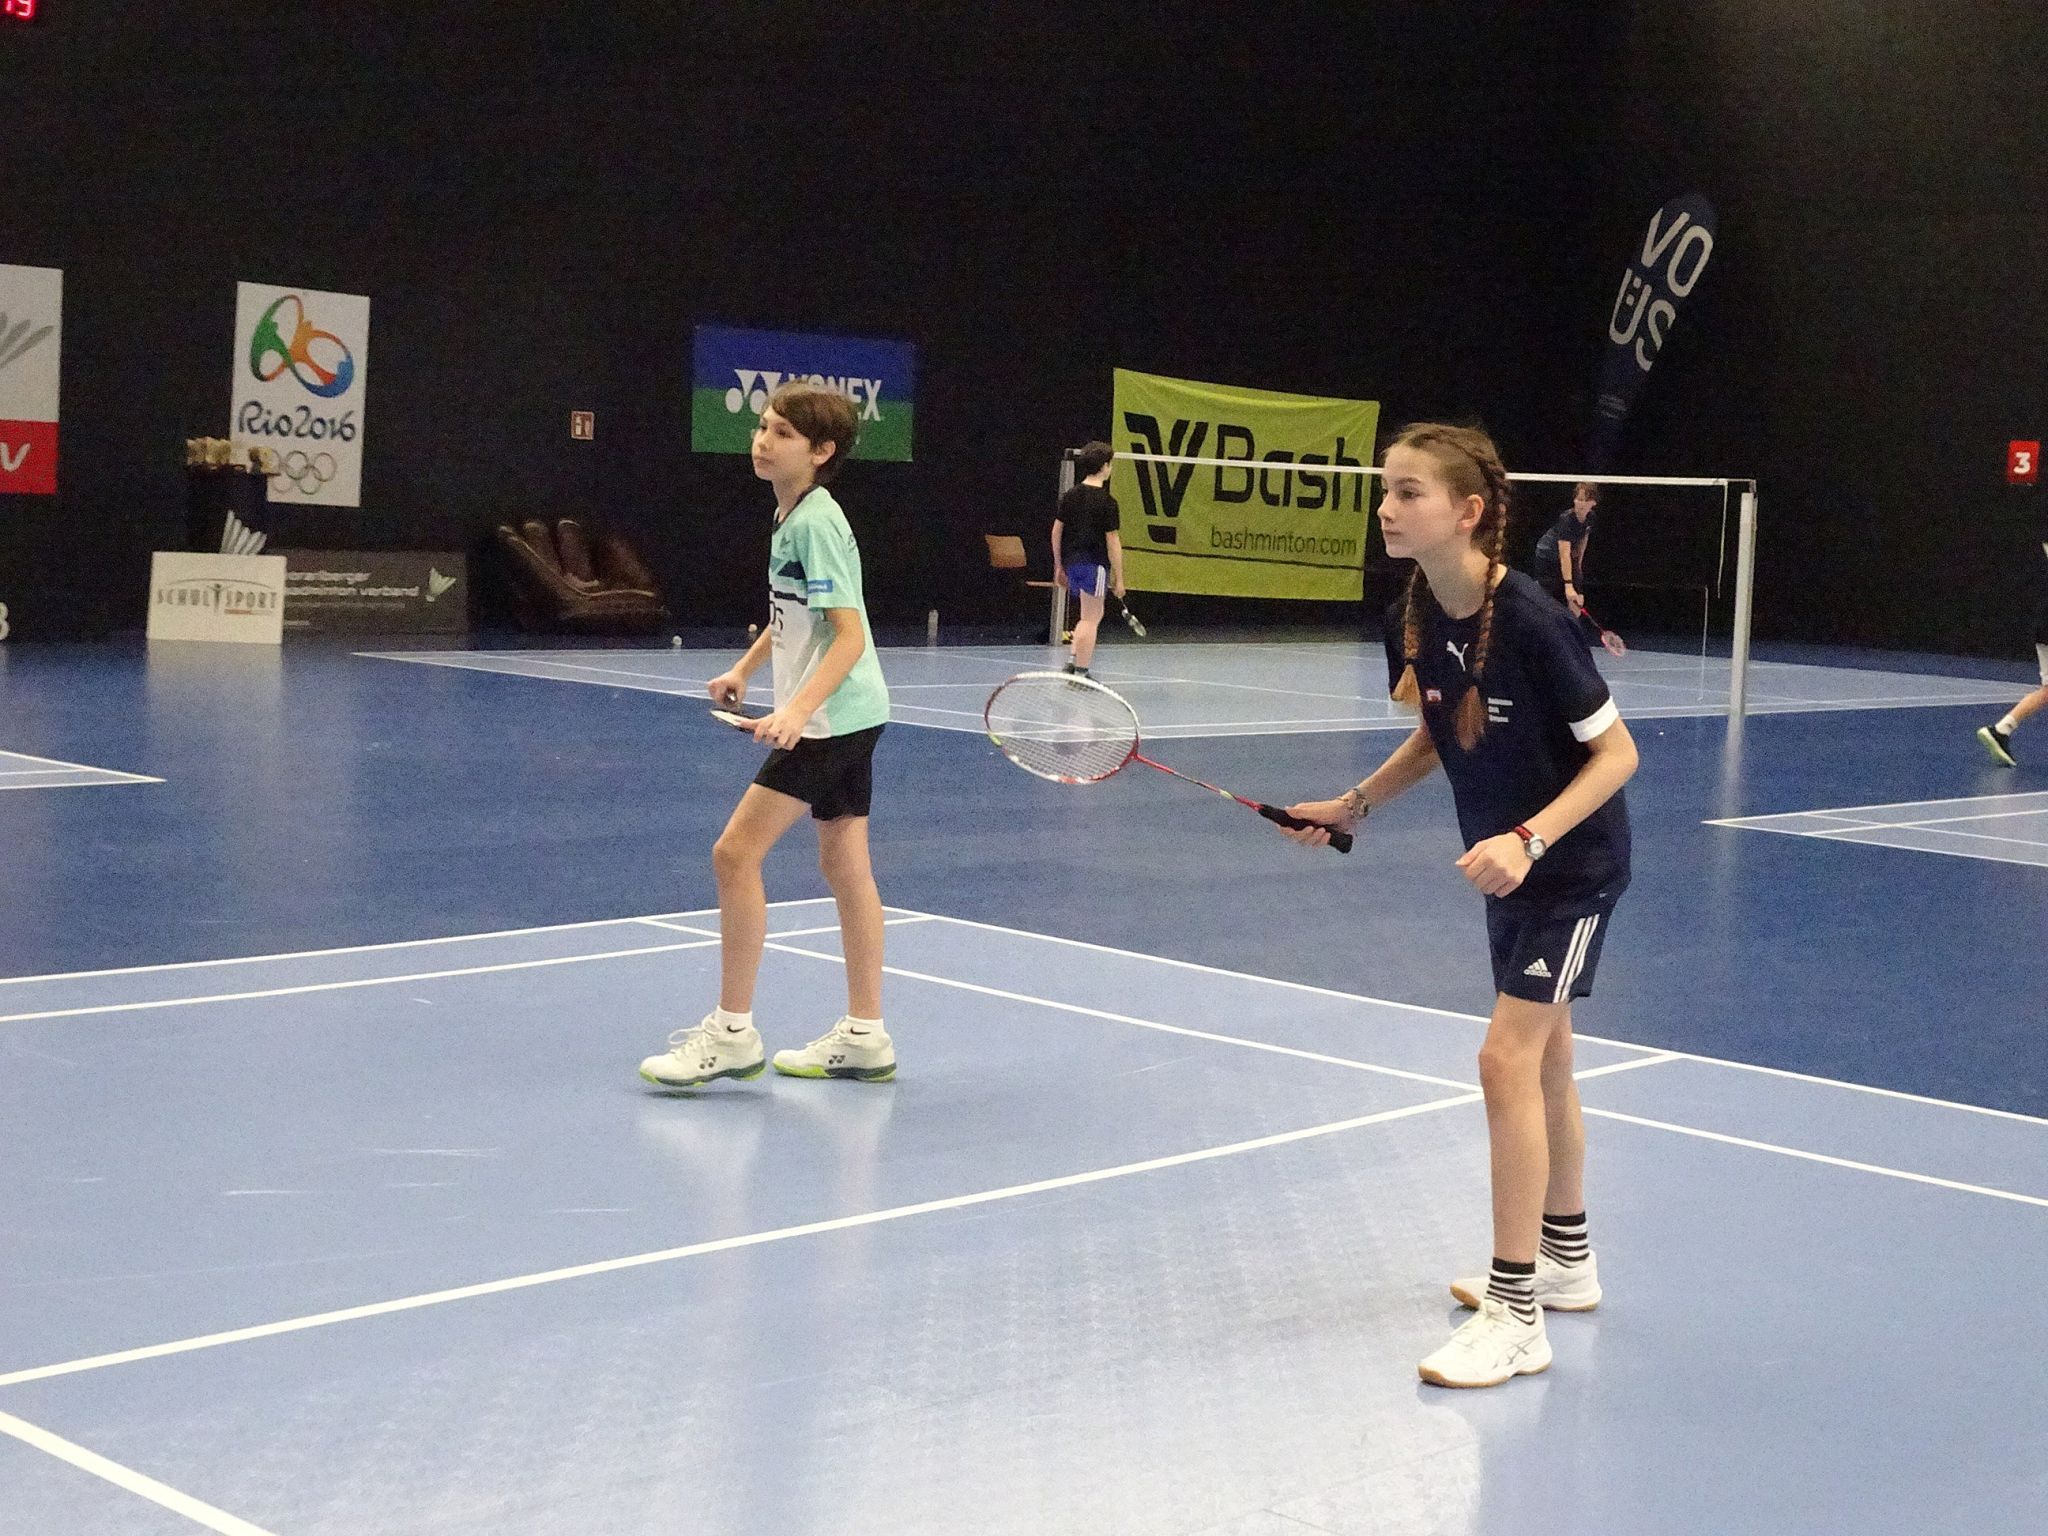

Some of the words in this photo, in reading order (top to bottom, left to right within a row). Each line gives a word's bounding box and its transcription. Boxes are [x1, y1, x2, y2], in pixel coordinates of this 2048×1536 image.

[1641, 207, 1713, 297] VO
[788, 373, 881, 421] NEX
[1213, 424, 1363, 512] Bash
[2014, 452, 2031, 474] 3
[1211, 526, 1357, 556] bashminton.com
